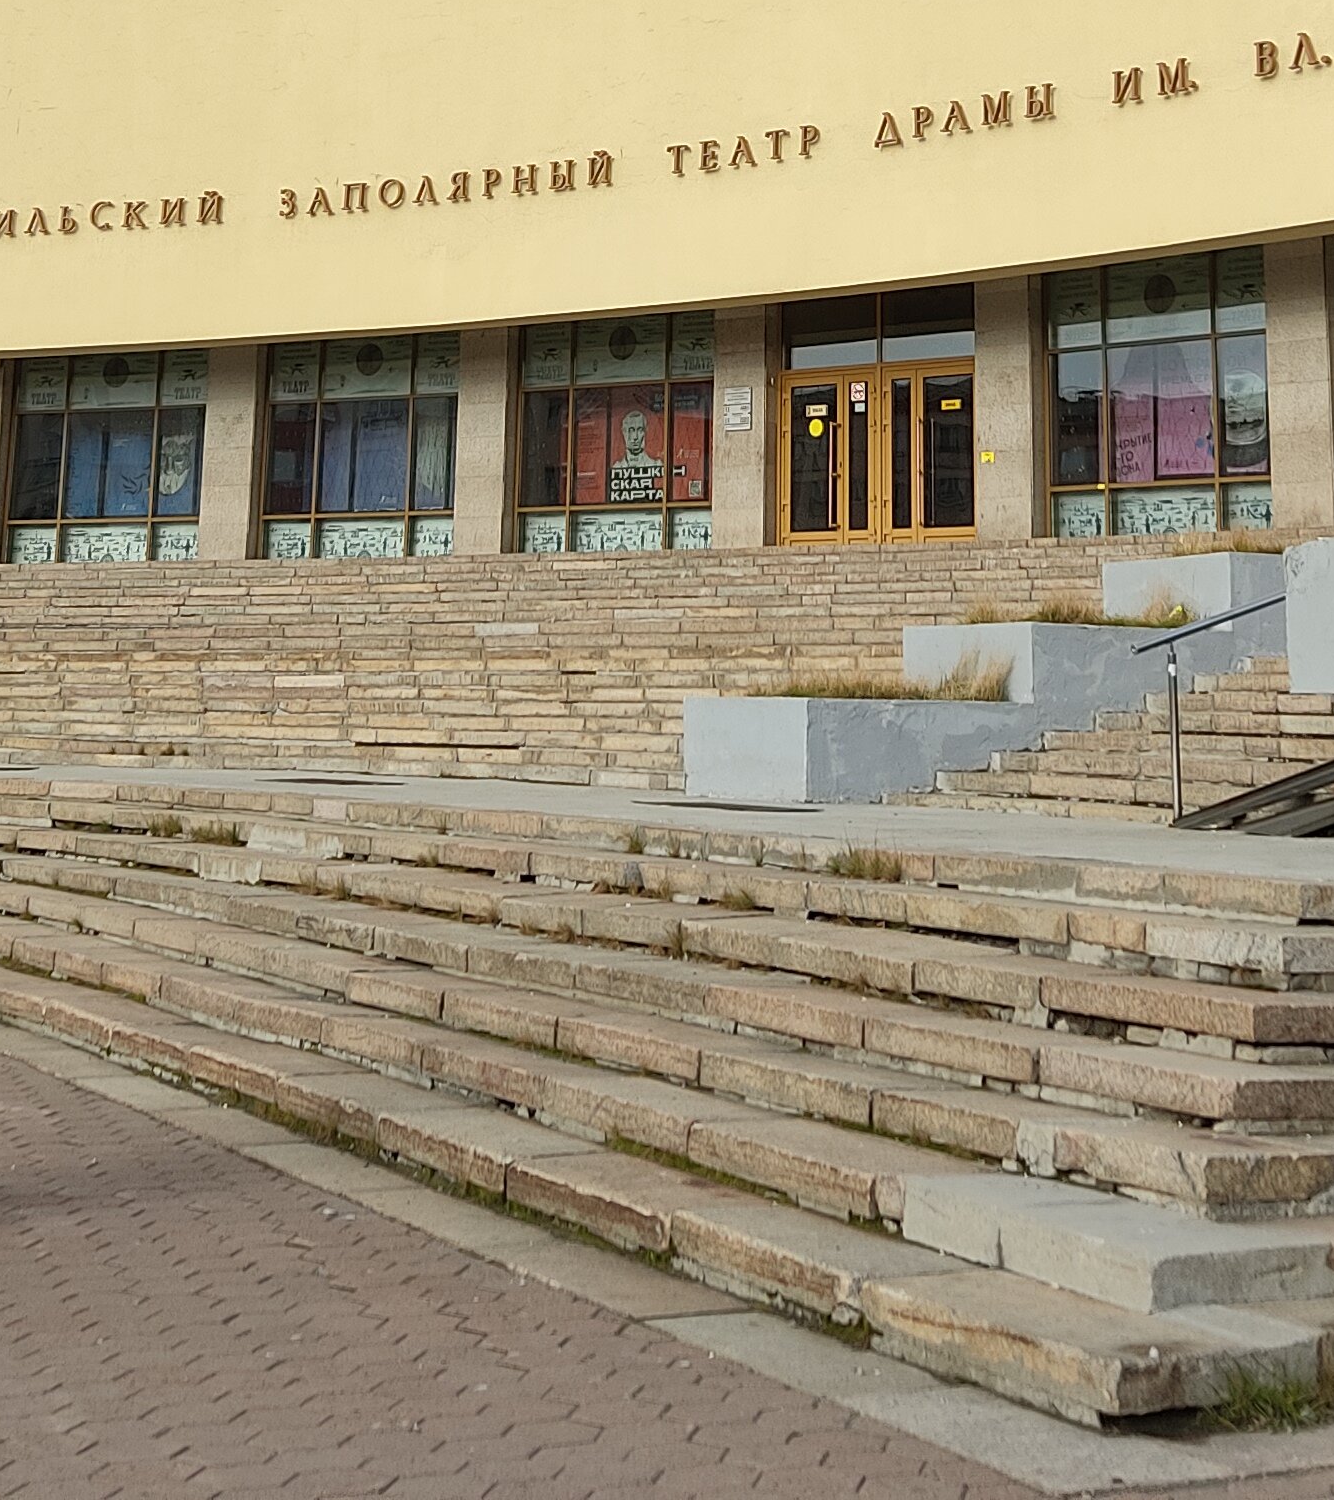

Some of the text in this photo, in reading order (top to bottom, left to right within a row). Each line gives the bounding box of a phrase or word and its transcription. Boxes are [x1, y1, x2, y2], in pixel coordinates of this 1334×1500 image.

[278, 149, 616, 220] ЗАПОЛЯРНЫЙ
[666, 125, 822, 178] ТЕАТР
[873, 81, 1058, 149] ДРАМЫ
[1111, 57, 1200, 109] ИМ.
[1253, 31, 1334, 82] ВЛ.
[610, 465, 686, 479] ПУШКН
[610, 479, 653, 490] СКАЯ
[610, 489, 665, 502] КАРТА
